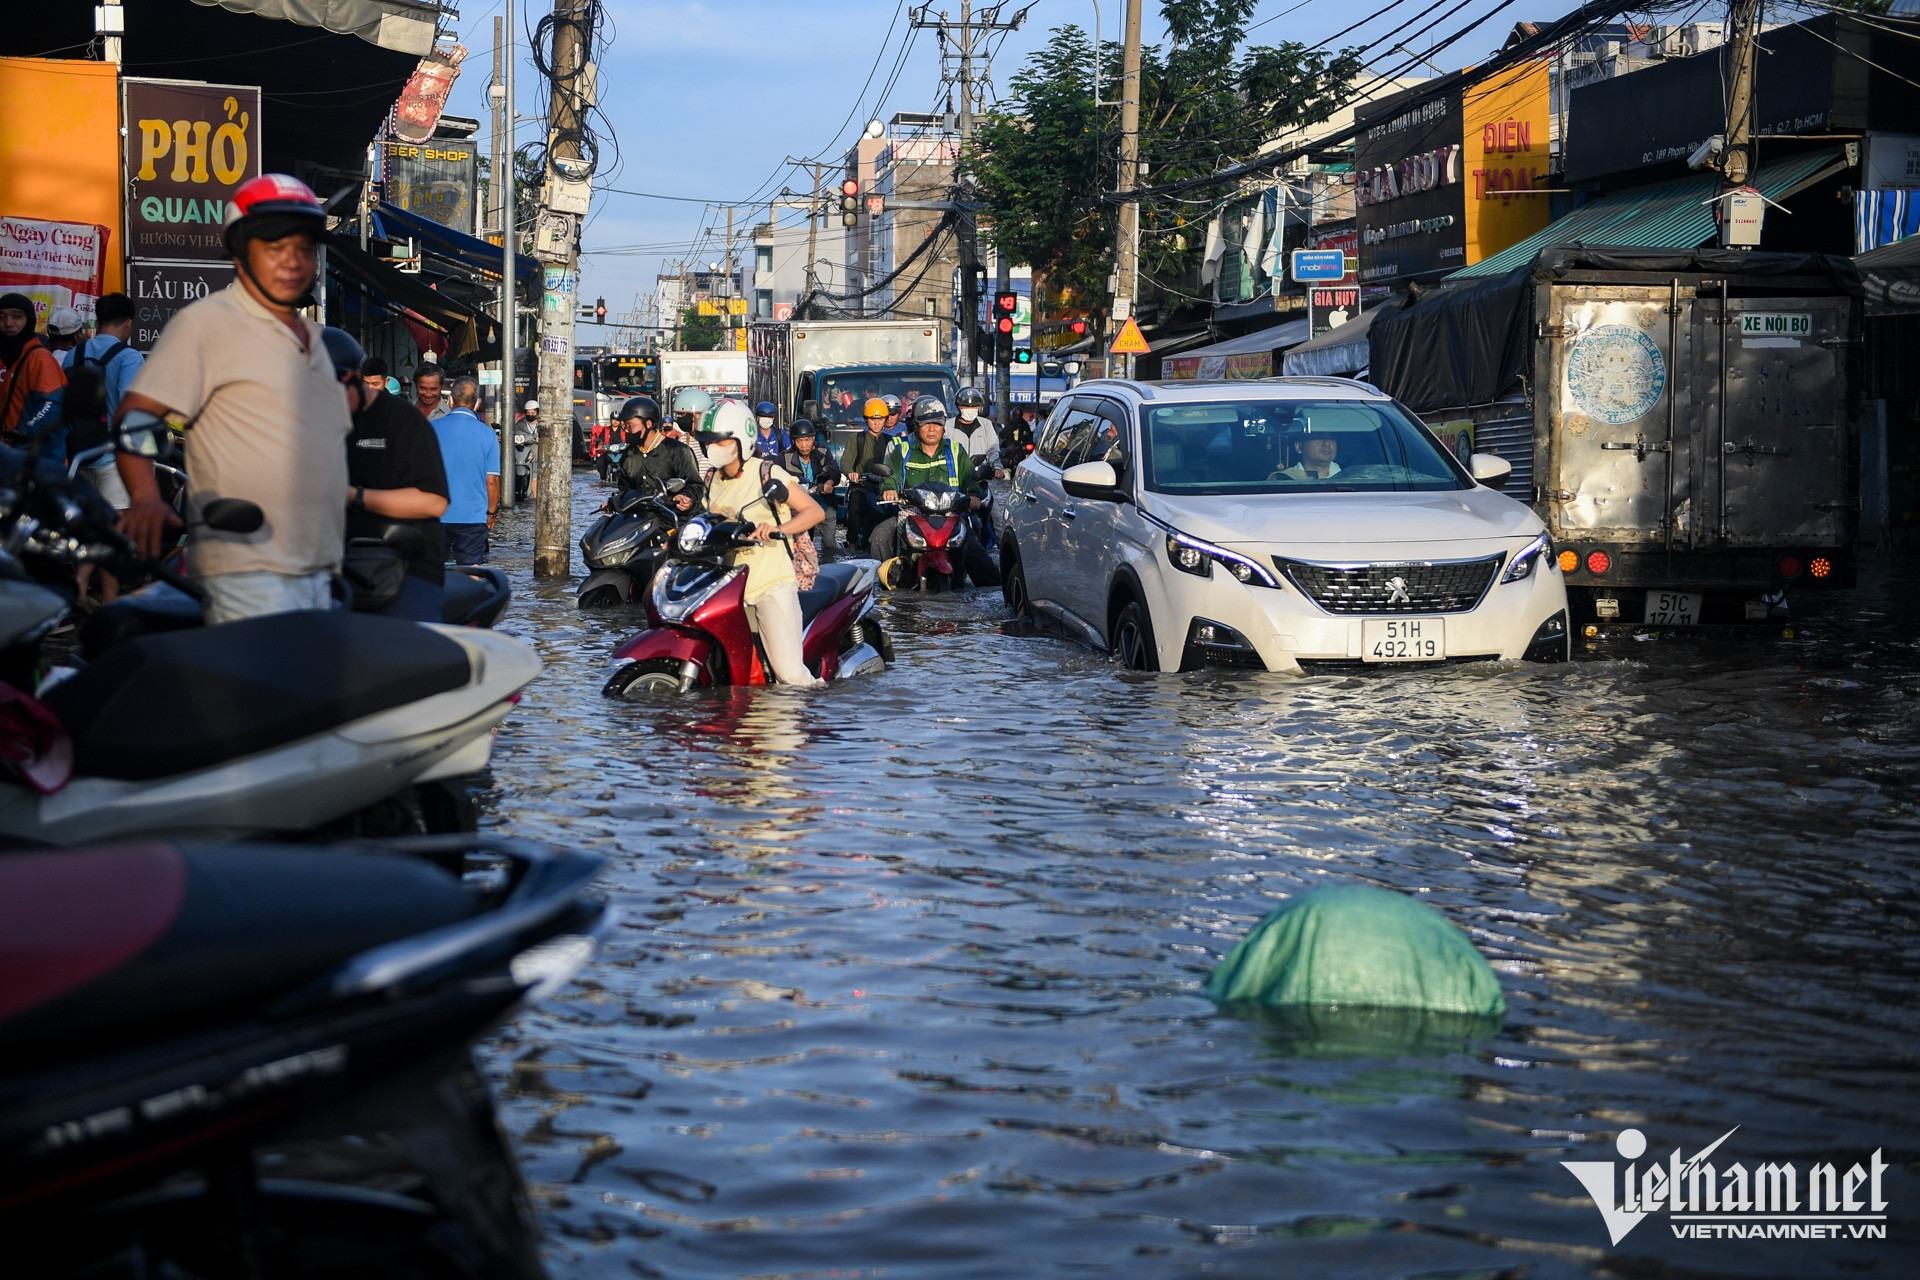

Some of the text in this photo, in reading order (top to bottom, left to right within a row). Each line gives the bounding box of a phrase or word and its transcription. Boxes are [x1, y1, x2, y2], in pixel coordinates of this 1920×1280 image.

[138, 96, 249, 185] PHỞ
[1483, 116, 1530, 158] ĐIỆN
[425, 149, 469, 161] SHOP
[1355, 144, 1460, 207] GIA HUY
[1473, 167, 1537, 206] THOẠI
[141, 197, 229, 225] QUAN
[1421, 215, 1454, 234] oppo
[1, 222, 94, 252] Ngày Cúng
[140, 232, 223, 248] HƯƠNG VỊ HÀ
[0, 246, 94, 267] Trọn Lễ Tiết Kiệm
[138, 271, 210, 299] LẨU BÒ
[1000, 296, 1015, 310] 49
[1314, 291, 1356, 306] GIA HUY
[139, 305, 162, 321] GÀ
[1744, 314, 1809, 334] XE NỘI BỘ
[139, 329, 160, 342] BIA
[1660, 594, 1689, 612] 51C
[1387, 621, 1421, 638] 51H
[1373, 640, 1435, 658] 492.19
